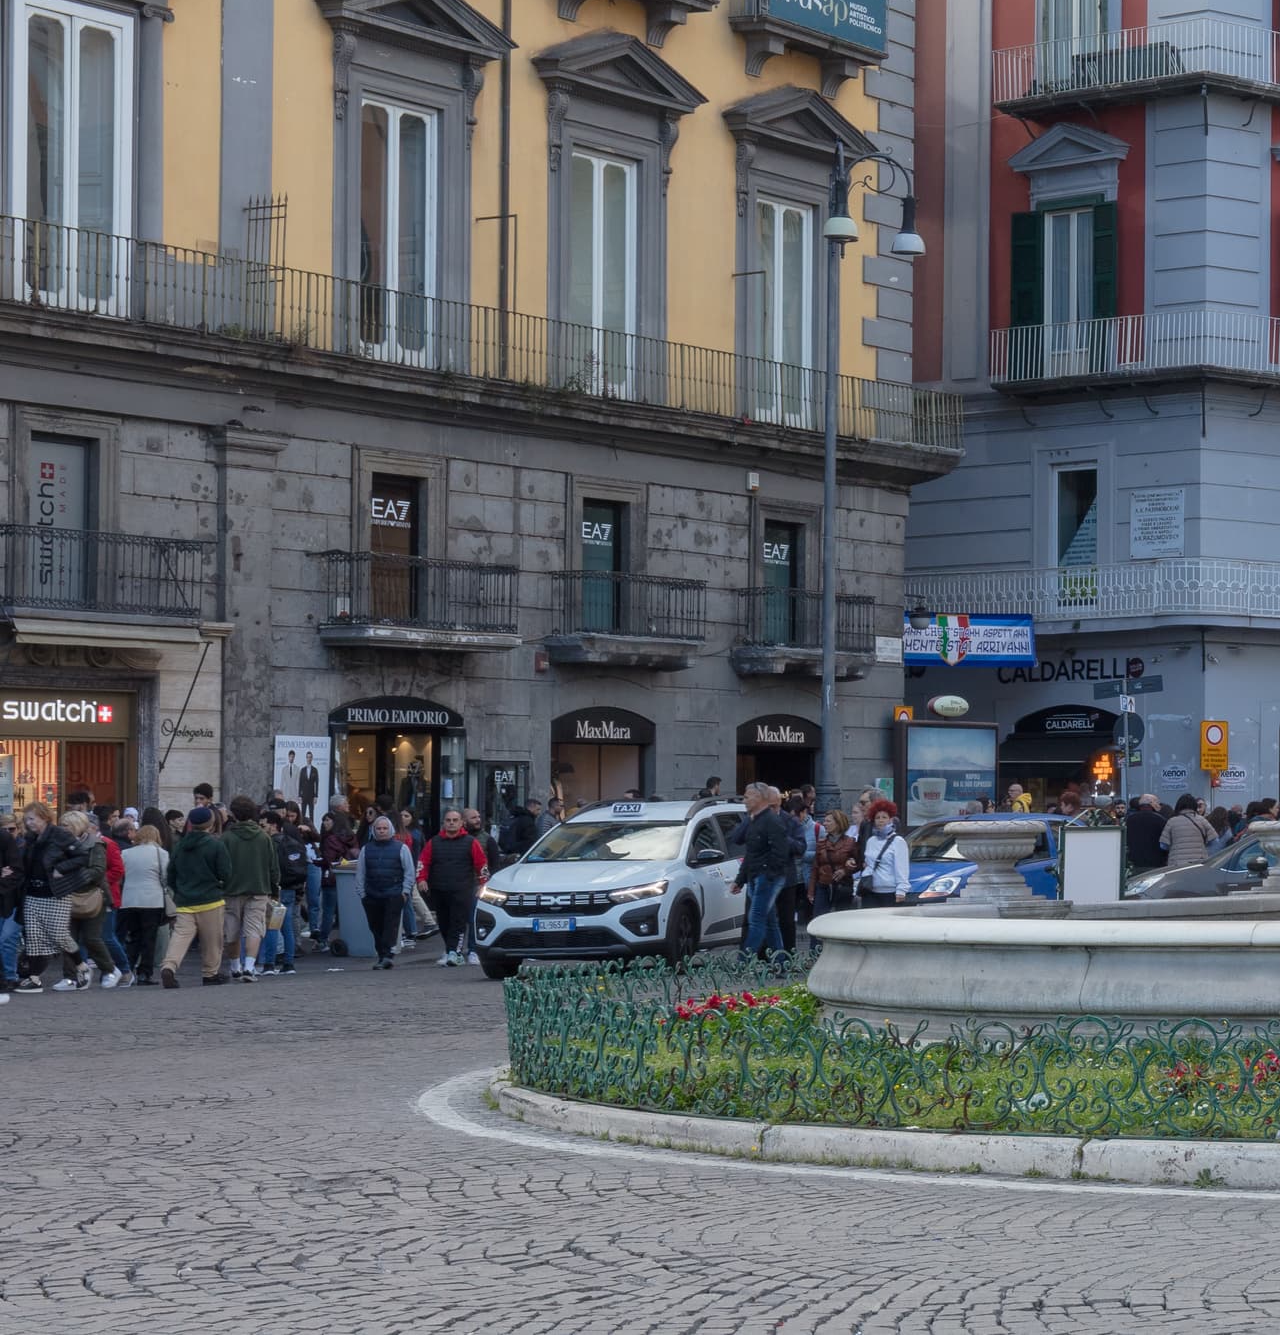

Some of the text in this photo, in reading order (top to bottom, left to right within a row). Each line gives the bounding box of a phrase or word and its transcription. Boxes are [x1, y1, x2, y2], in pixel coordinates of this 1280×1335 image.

[849, 2, 868, 13] MUSEO
[848, 18, 882, 35] POLITECNICO
[849, 11, 876, 24] ARTISTICO
[371, 497, 411, 521] EA7
[581, 521, 613, 541] EA7
[763, 542, 791, 560] EA7
[997, 657, 1130, 684] CALDARELLI
[2, 699, 97, 723] swatch
[347, 707, 449, 725] PRIMO EMPORIO
[160, 718, 215, 743] Orologeria
[576, 720, 631, 740] MaxMara
[756, 724, 805, 745] MaxMara
[494, 770, 515, 783] EA7
[614, 804, 641, 813] TAXI
